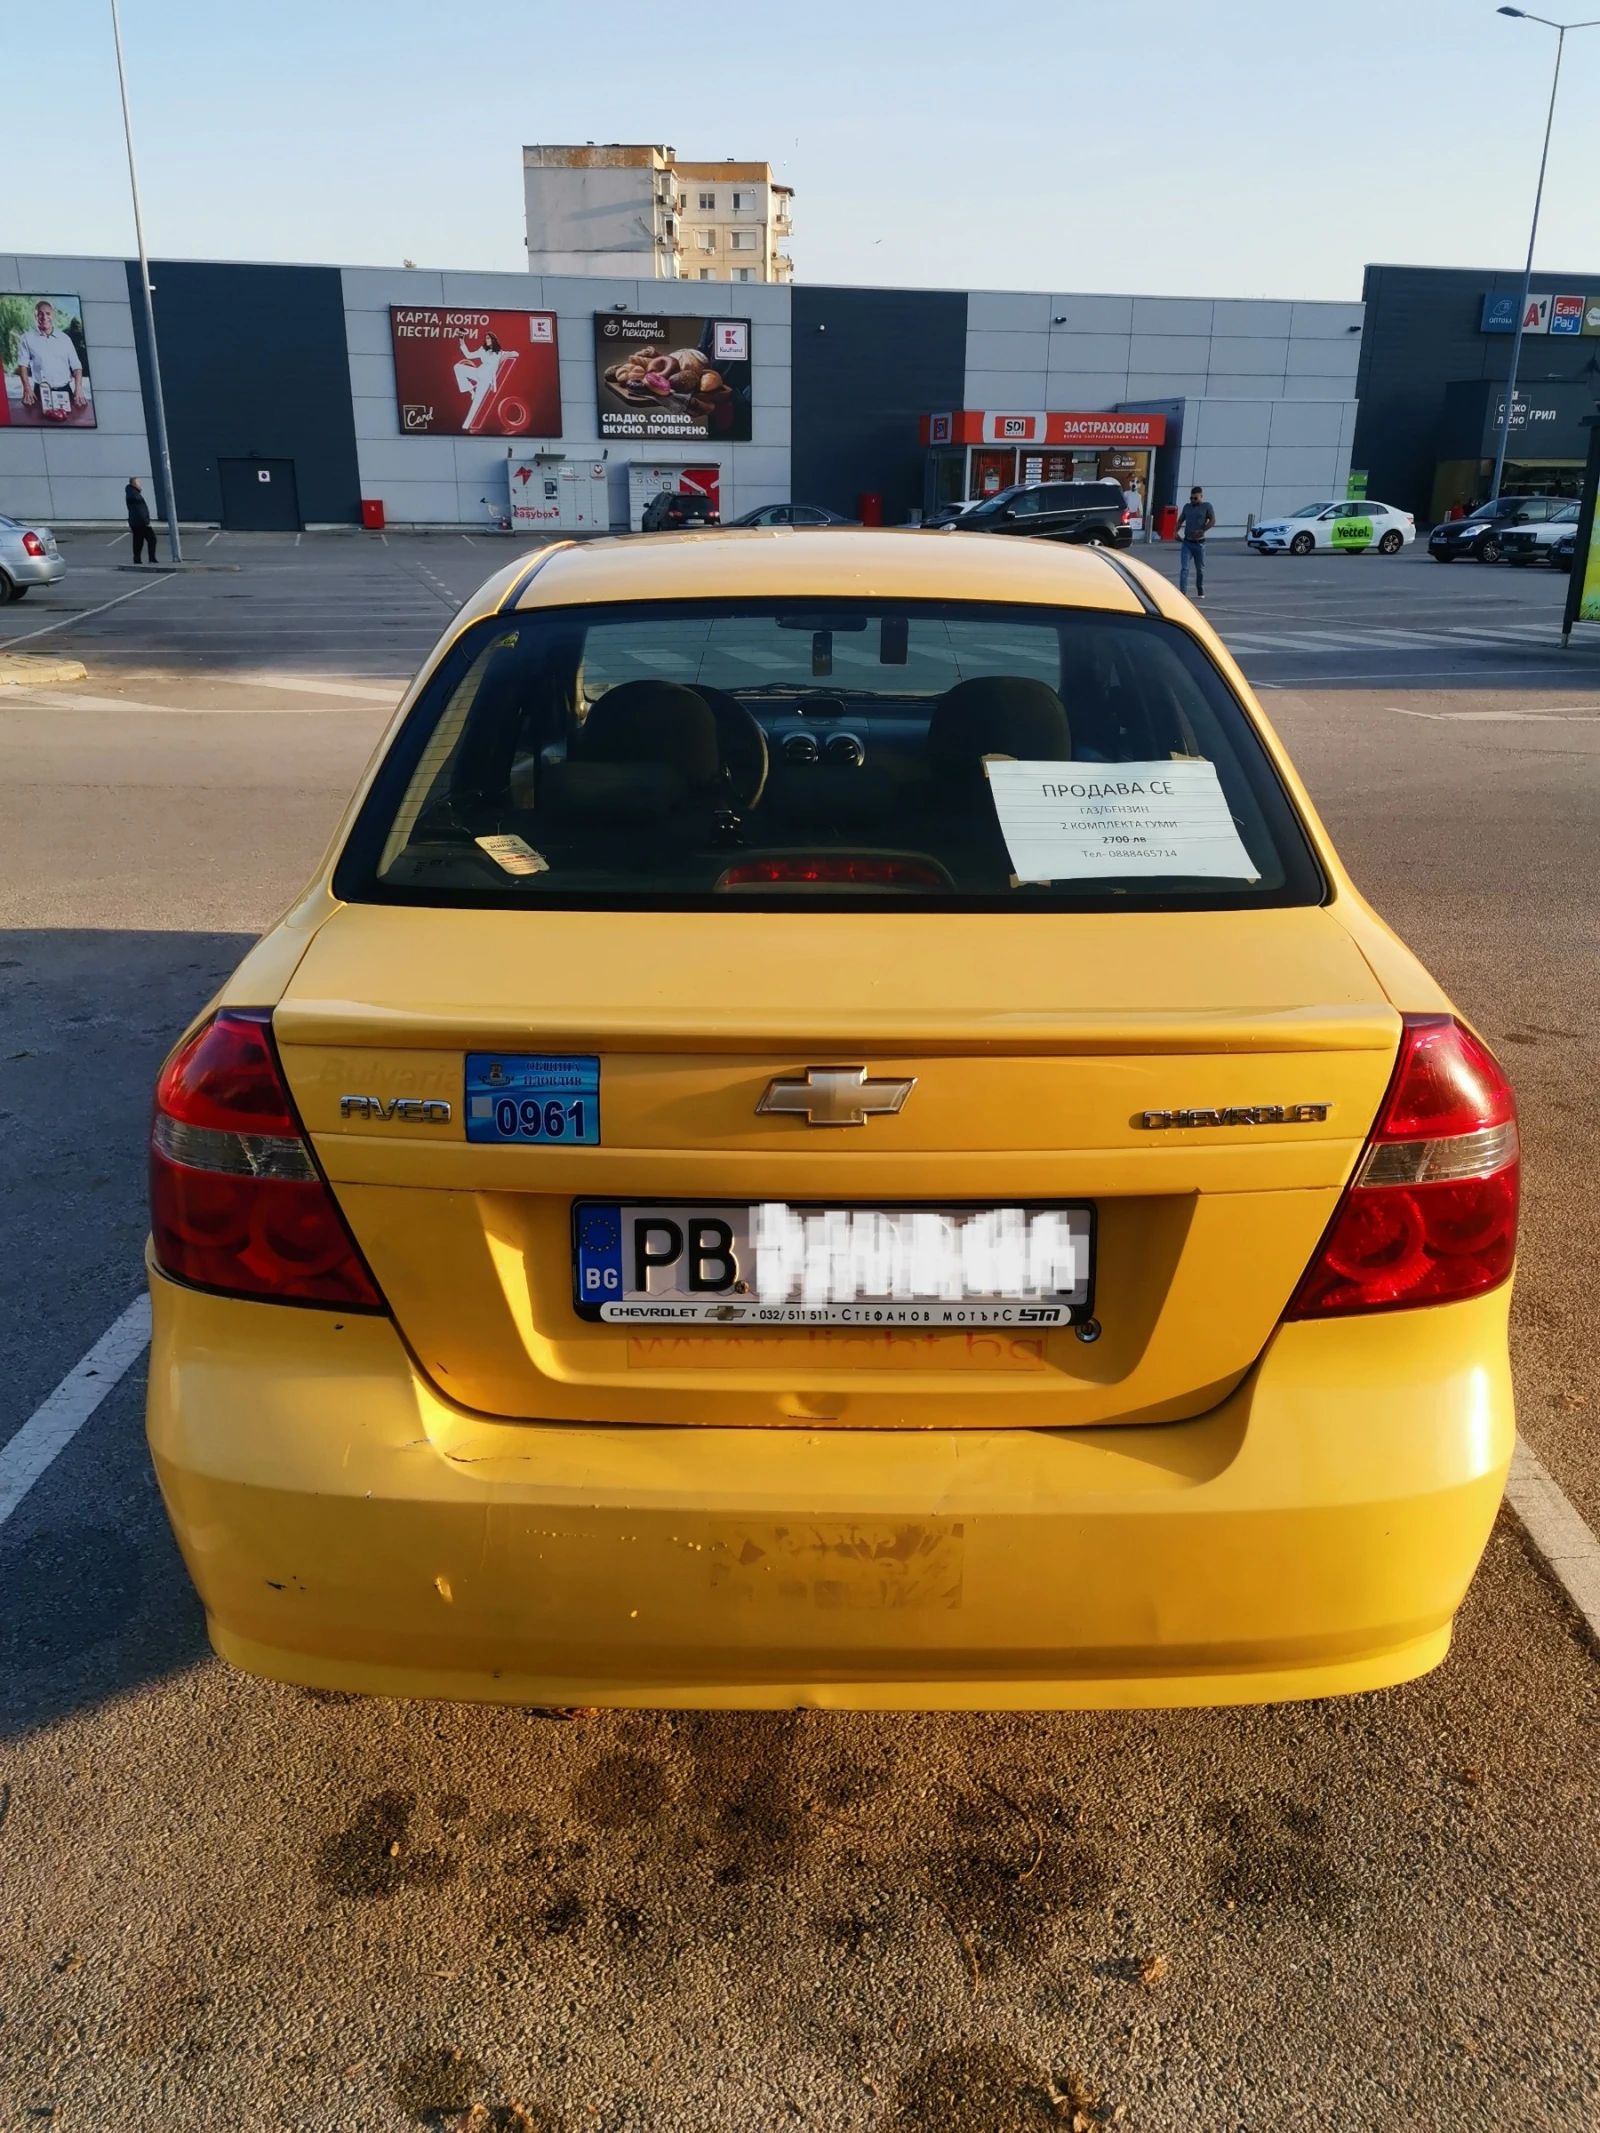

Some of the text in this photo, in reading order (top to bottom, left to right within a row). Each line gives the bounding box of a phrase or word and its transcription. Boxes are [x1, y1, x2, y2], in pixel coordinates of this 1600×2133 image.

[1523, 300, 1547, 327] A1
[1556, 303, 1581, 317] Easy
[396, 312, 489, 326] КАРТА, КОЯТО
[622, 320, 658, 329] Kaufland
[1554, 316, 1574, 330] Pay
[398, 326, 479, 339] ПЕСТИ ПАРИ
[622, 328, 665, 339] пекарна
[1498, 403, 1526, 412] СЕЖО
[407, 407, 434, 426] Card
[602, 413, 693, 424] СЛАДКО. СОЛЕНО.
[1497, 416, 1525, 424] ЛСНО
[1529, 410, 1556, 420] ГРИЛ
[603, 425, 709, 435] ВКУСНО. ПРОВЕРЕНО.
[1006, 421, 1024, 431] SDI
[1064, 421, 1149, 433] ЗАСТРАХОВКИ
[514, 509, 554, 519] easybox
[1337, 526, 1370, 538] Yettel.
[1042, 781, 1175, 799] ПРОДАВА СЕ
[1080, 806, 1149, 815] ГАЗ/БЕНЗИН
[1061, 820, 1178, 830] 2 КОМПЛЕКТА ГУМИ
[1102, 835, 1129, 844] 2700
[1108, 849, 1177, 858] 0888465714
[526, 1061, 580, 1072] ОБЩИНА
[523, 1074, 582, 1087] ПЛОВДИВ
[340, 1095, 451, 1124] AVEO
[495, 1098, 586, 1139] 0961
[1142, 1103, 1335, 1130] CHEVROLET
[586, 1268, 618, 1289] BG
[610, 1307, 698, 1317] CHEVROLET
[788, 1310, 805, 1320] 511
[842, 1308, 930, 1321] СТЕФАНОВ
[943, 1308, 1012, 1321] МОТЪРС
